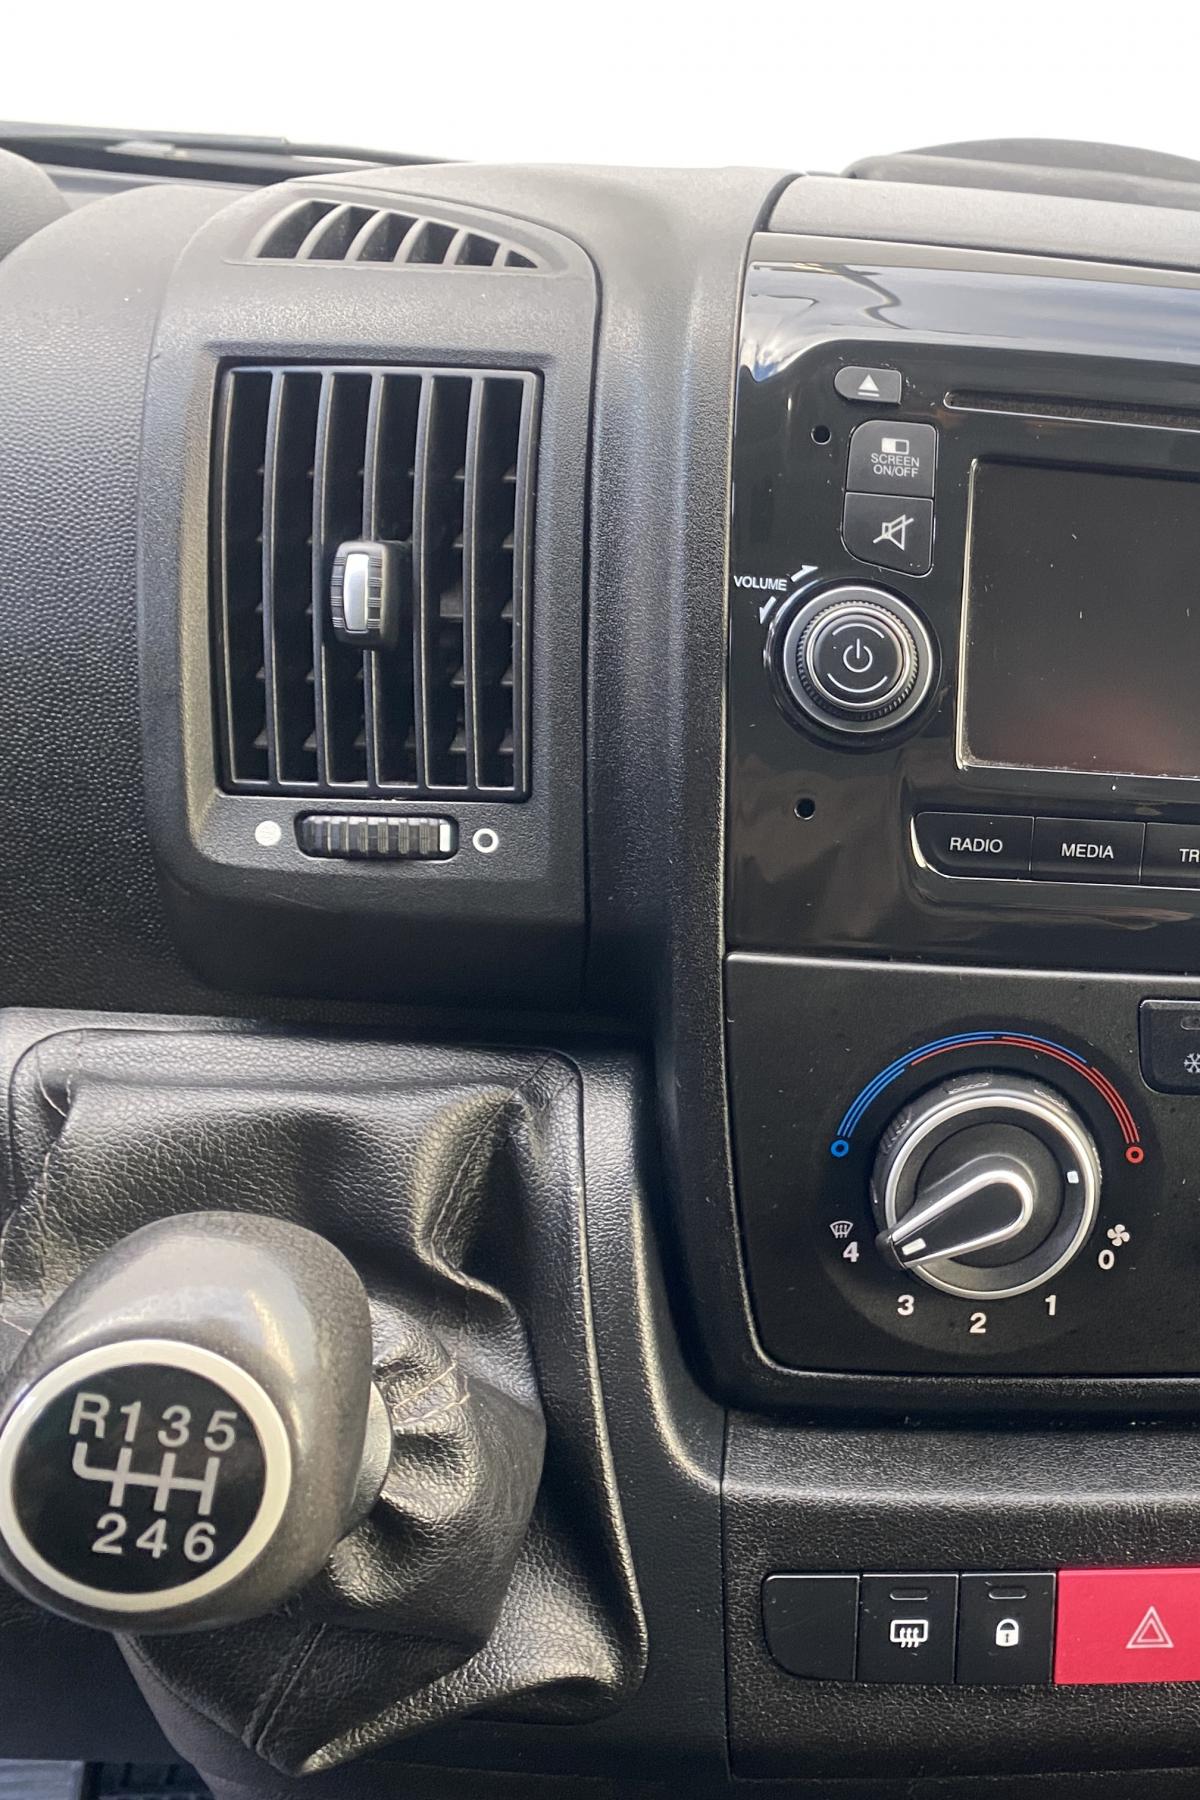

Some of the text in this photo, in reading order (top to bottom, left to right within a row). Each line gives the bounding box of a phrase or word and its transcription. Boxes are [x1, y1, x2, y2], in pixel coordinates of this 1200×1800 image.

[870, 453, 920, 468] SCREEN
[873, 465, 919, 478] ON/OFF
[734, 575, 788, 592] VOLUME
[949, 836, 1004, 854] RADIO
[1061, 842, 1115, 860] MEDIA
[842, 1241, 860, 1263] 4
[1097, 1249, 1116, 1270] 0
[896, 1294, 915, 1316] 3
[1044, 1294, 1057, 1316] 1
[969, 1312, 988, 1335] 2
[68, 1392, 239, 1452] R 1 3 5
[91, 1512, 217, 1563] 2 4 6
